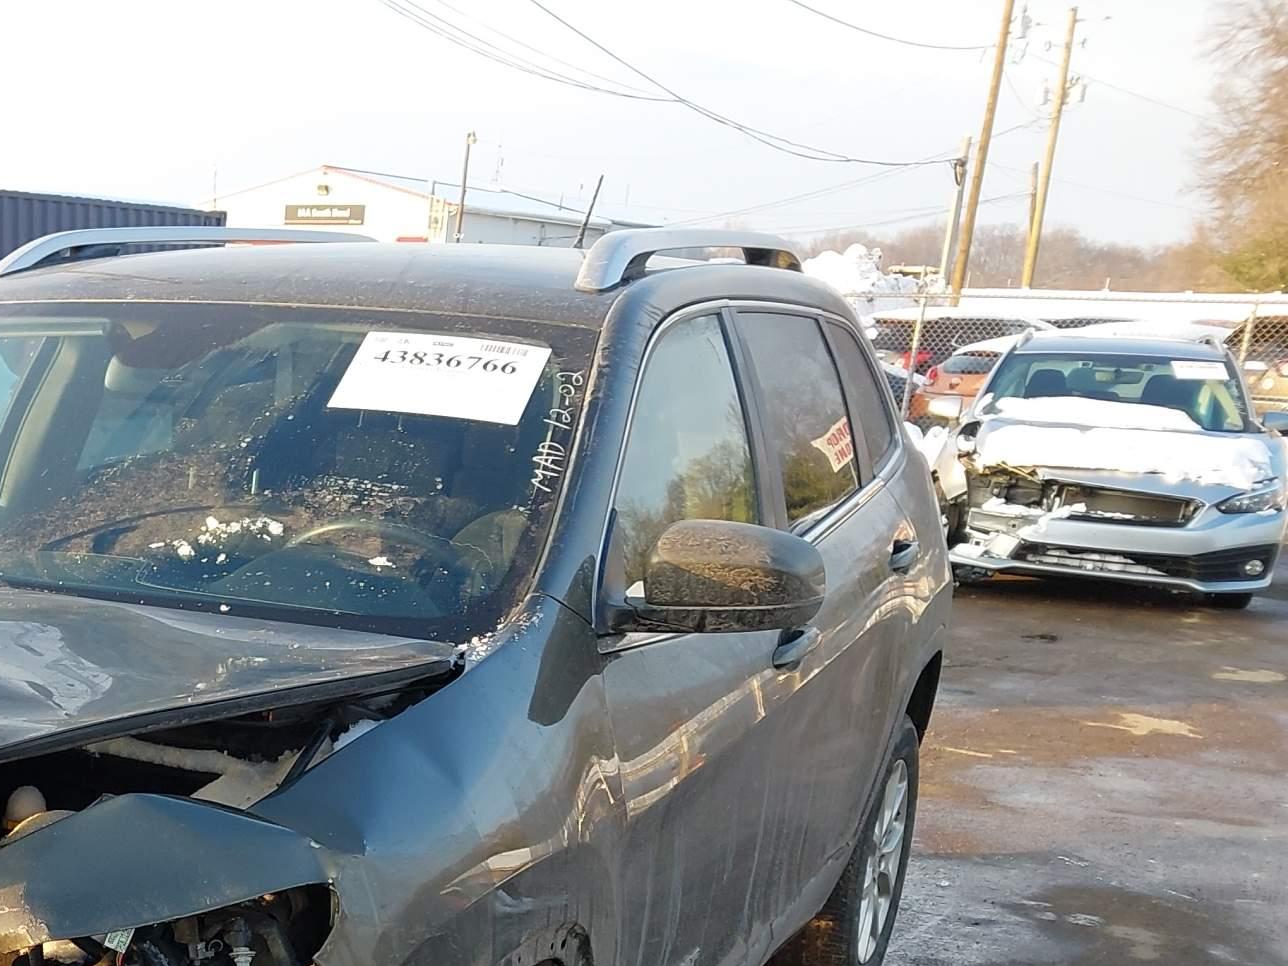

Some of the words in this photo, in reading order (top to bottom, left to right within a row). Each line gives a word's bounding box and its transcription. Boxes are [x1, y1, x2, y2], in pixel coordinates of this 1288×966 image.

[373, 349, 519, 375] 43836766
[543, 371, 584, 430] 12-02
[530, 440, 565, 492] MAD
